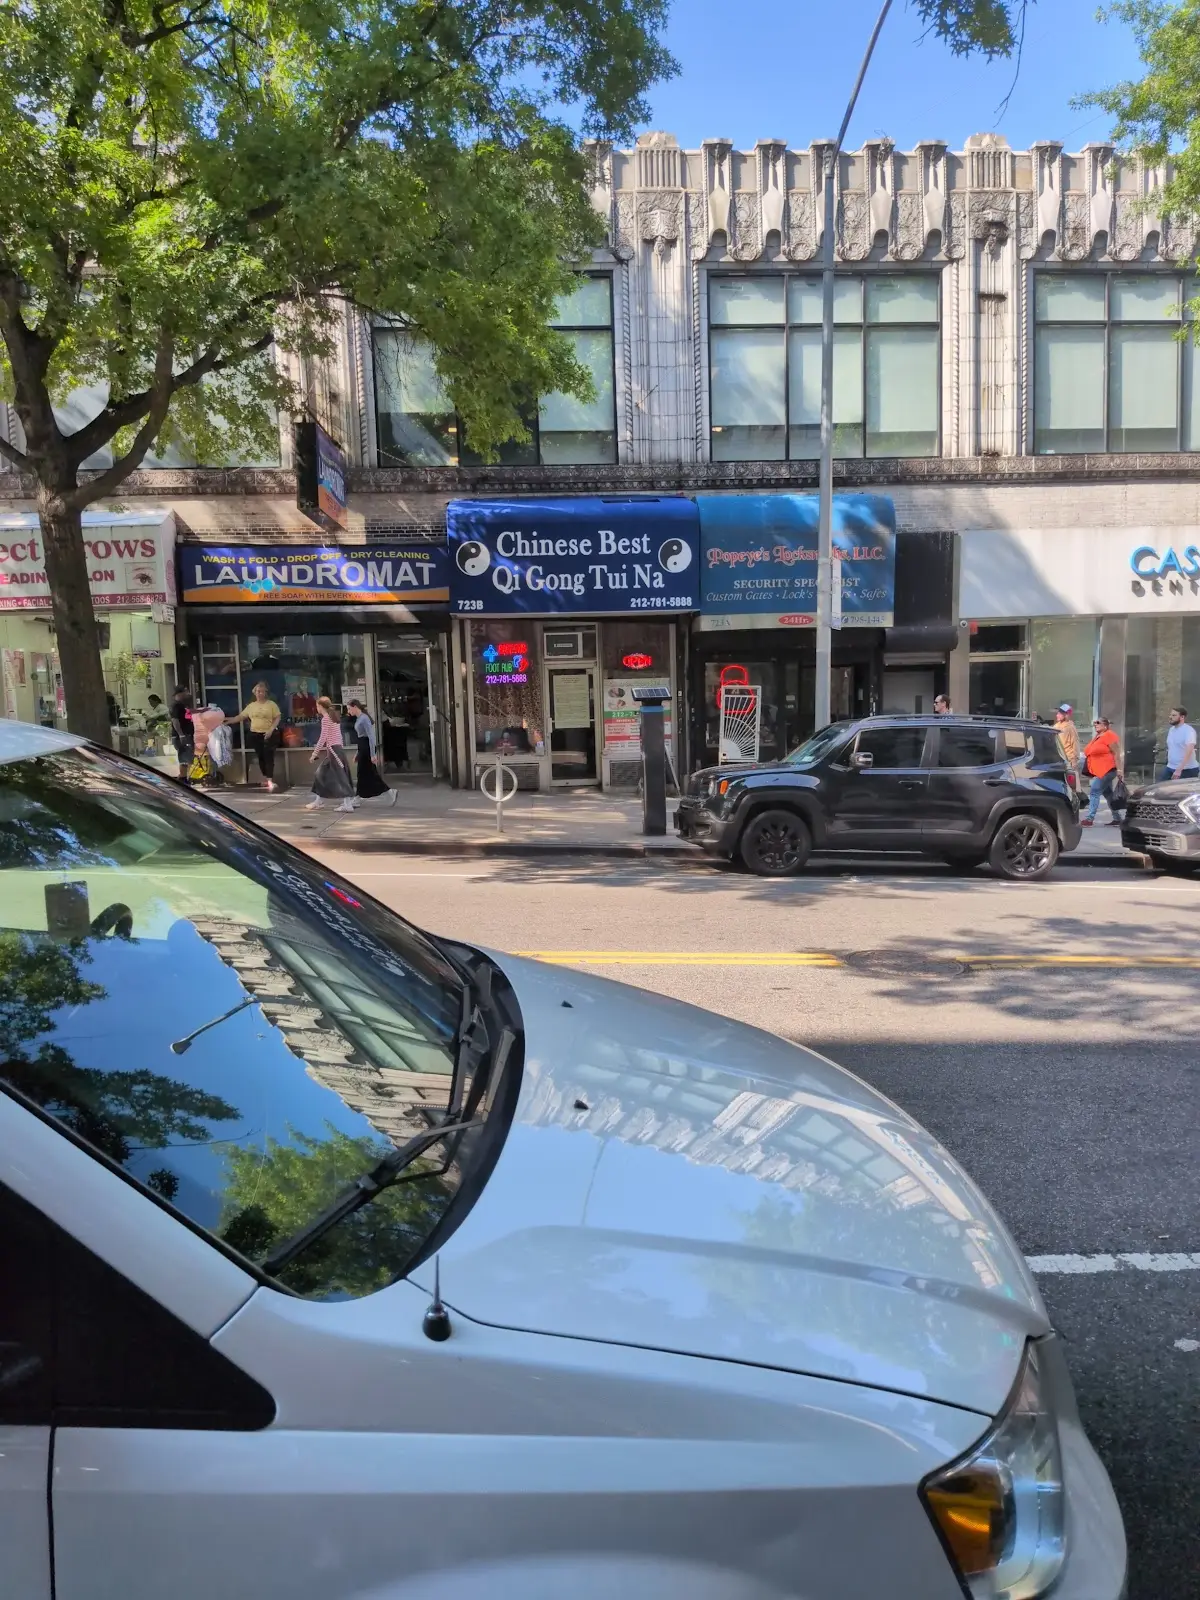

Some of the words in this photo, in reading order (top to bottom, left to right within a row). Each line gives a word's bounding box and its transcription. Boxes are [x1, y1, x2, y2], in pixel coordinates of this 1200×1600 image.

[496, 531, 592, 557] Chinese
[598, 530, 651, 555] Best
[203, 555, 235, 564] WASH
[249, 556, 278, 564] FOLD
[287, 554, 318, 563] DROP
[320, 552, 342, 561] OFF
[350, 551, 372, 559] DRY
[375, 551, 430, 560] CLEANING
[706, 547, 770, 568] Popeye's
[772, 545, 852, 566] Locksmhs,
[0, 572, 47, 584] EADIN
[195, 561, 437, 587] LAUNDROMAT
[492, 565, 521, 594] Qi
[525, 566, 585, 596] Gong
[588, 564, 628, 590] Tui
[633, 563, 665, 589] Na
[733, 579, 790, 589] SECURITY
[794, 577, 861, 588] SPEIST
[706, 592, 742, 602] Custom
[745, 591, 773, 600] Gates
[782, 589, 814, 599] Lock's
[860, 589, 887, 600] Safes
[23, 598, 49, 608] FACIAL
[457, 600, 484, 610] 723B
[485, 663, 500, 673] FOOT
